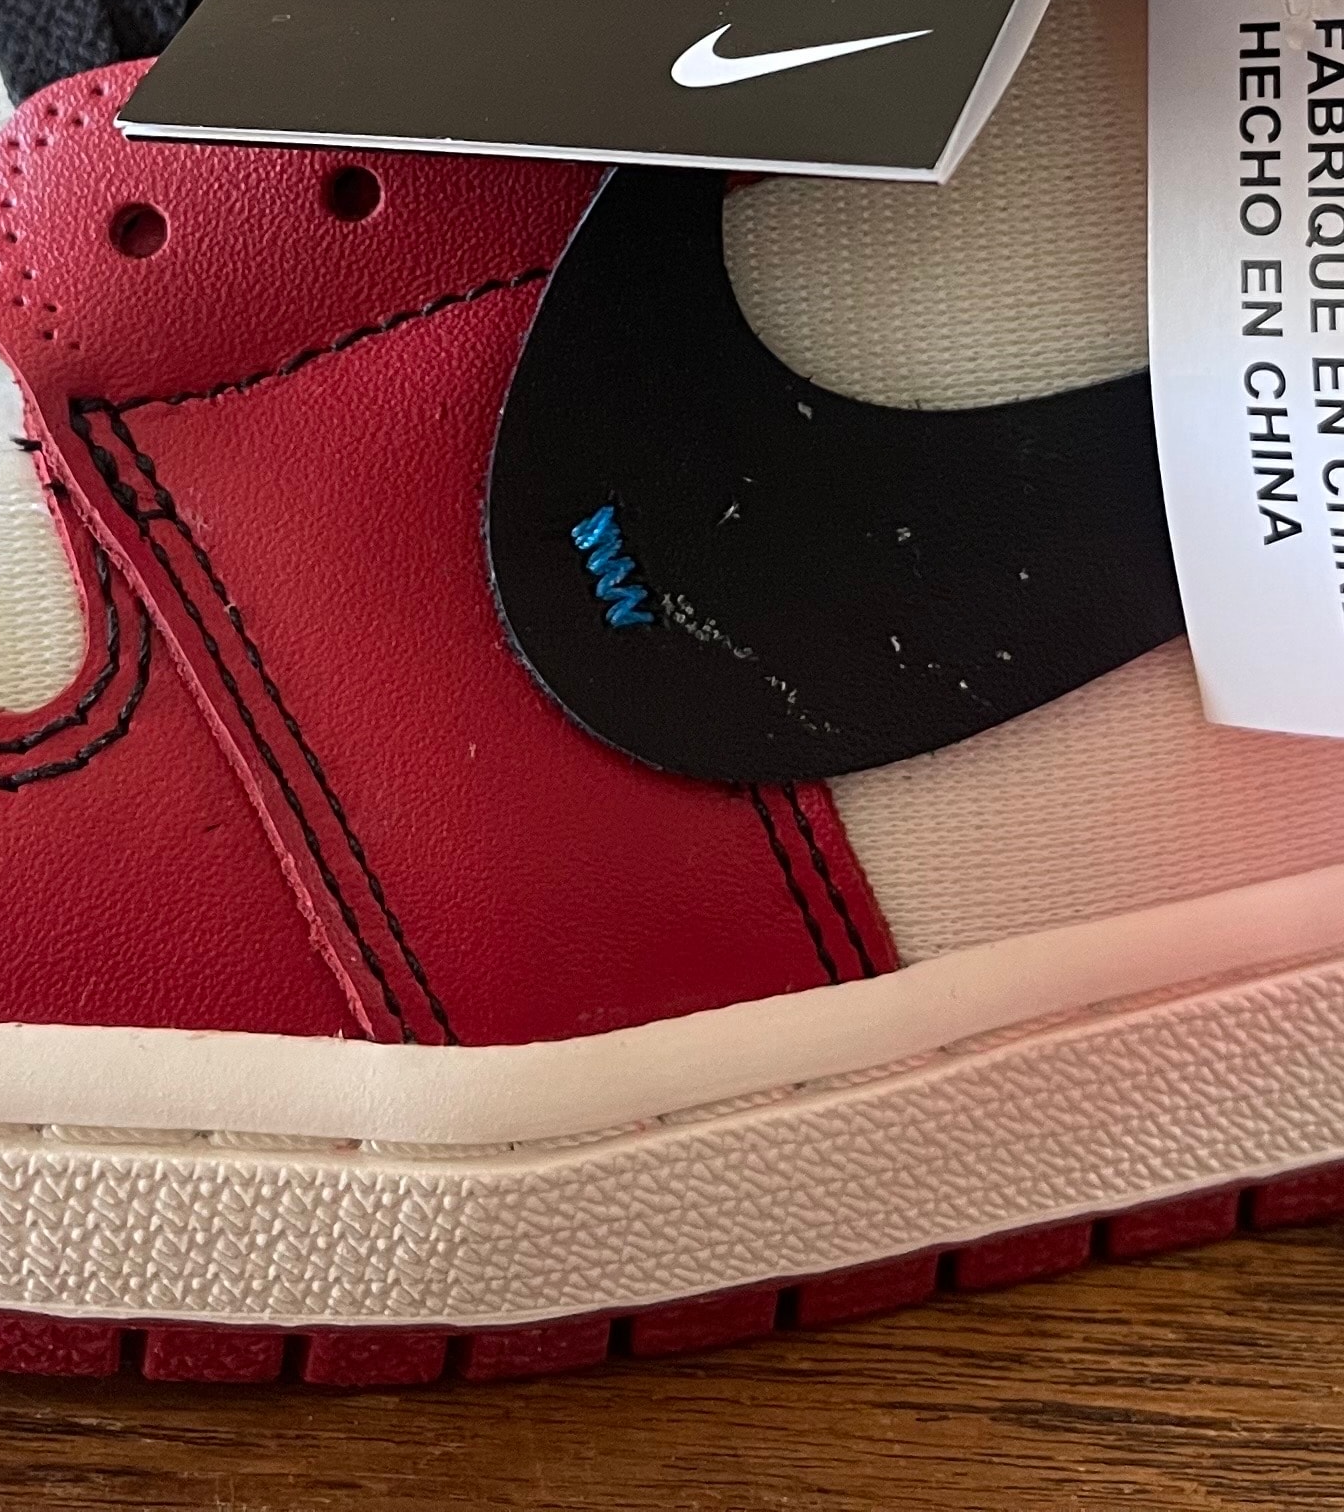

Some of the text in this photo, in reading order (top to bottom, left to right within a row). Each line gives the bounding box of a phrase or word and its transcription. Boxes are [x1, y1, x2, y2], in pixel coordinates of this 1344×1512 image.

[1239, 20, 1303, 547] HECHO EN CHINA
